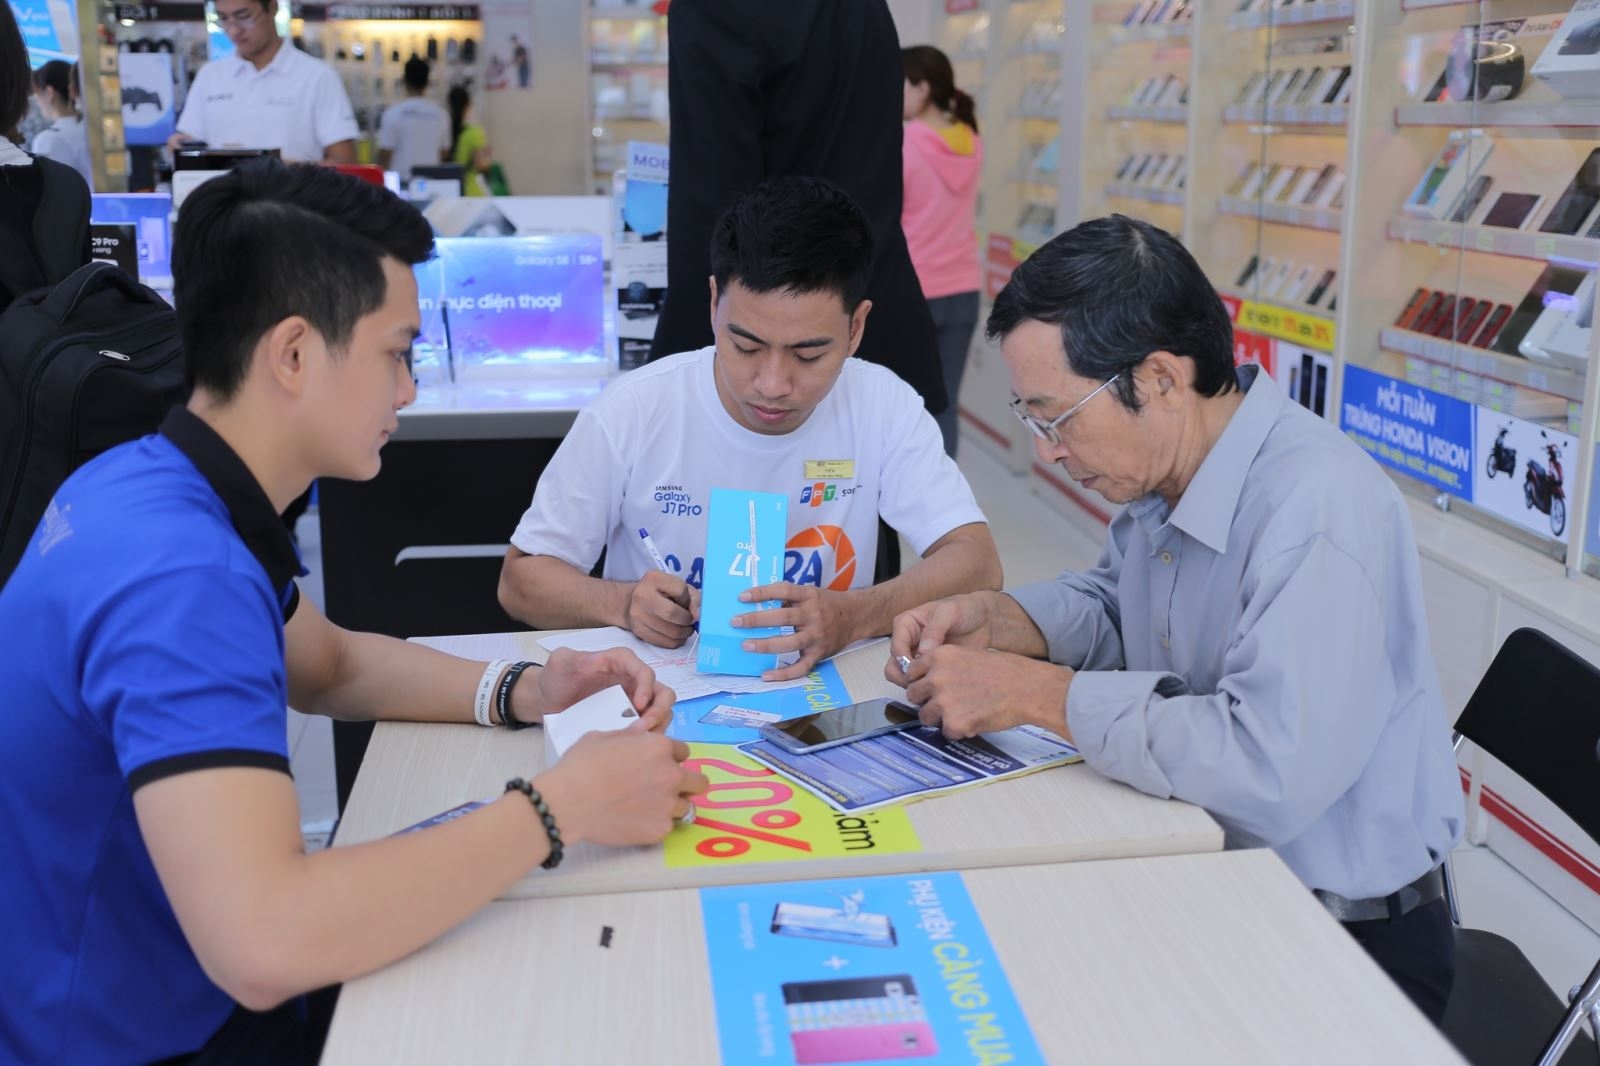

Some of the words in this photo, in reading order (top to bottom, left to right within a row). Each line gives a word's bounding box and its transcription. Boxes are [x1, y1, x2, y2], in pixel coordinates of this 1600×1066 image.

[103, 237, 119, 246] Pro
[515, 255, 554, 268] Galaxy
[556, 255, 569, 266] S8
[478, 292, 516, 314] điện
[518, 292, 563, 313] thoại
[1381, 416, 1425, 455] HONDA
[1426, 432, 1470, 473] VISION
[654, 492, 691, 504] Galaxy
[801, 485, 836, 503] FPT
[728, 553, 761, 577] J7
[907, 879, 940, 906] PHỤ
[915, 905, 957, 941] KIỆN
[932, 941, 991, 1010] CÀNG
[958, 1011, 1015, 1066] MUA
